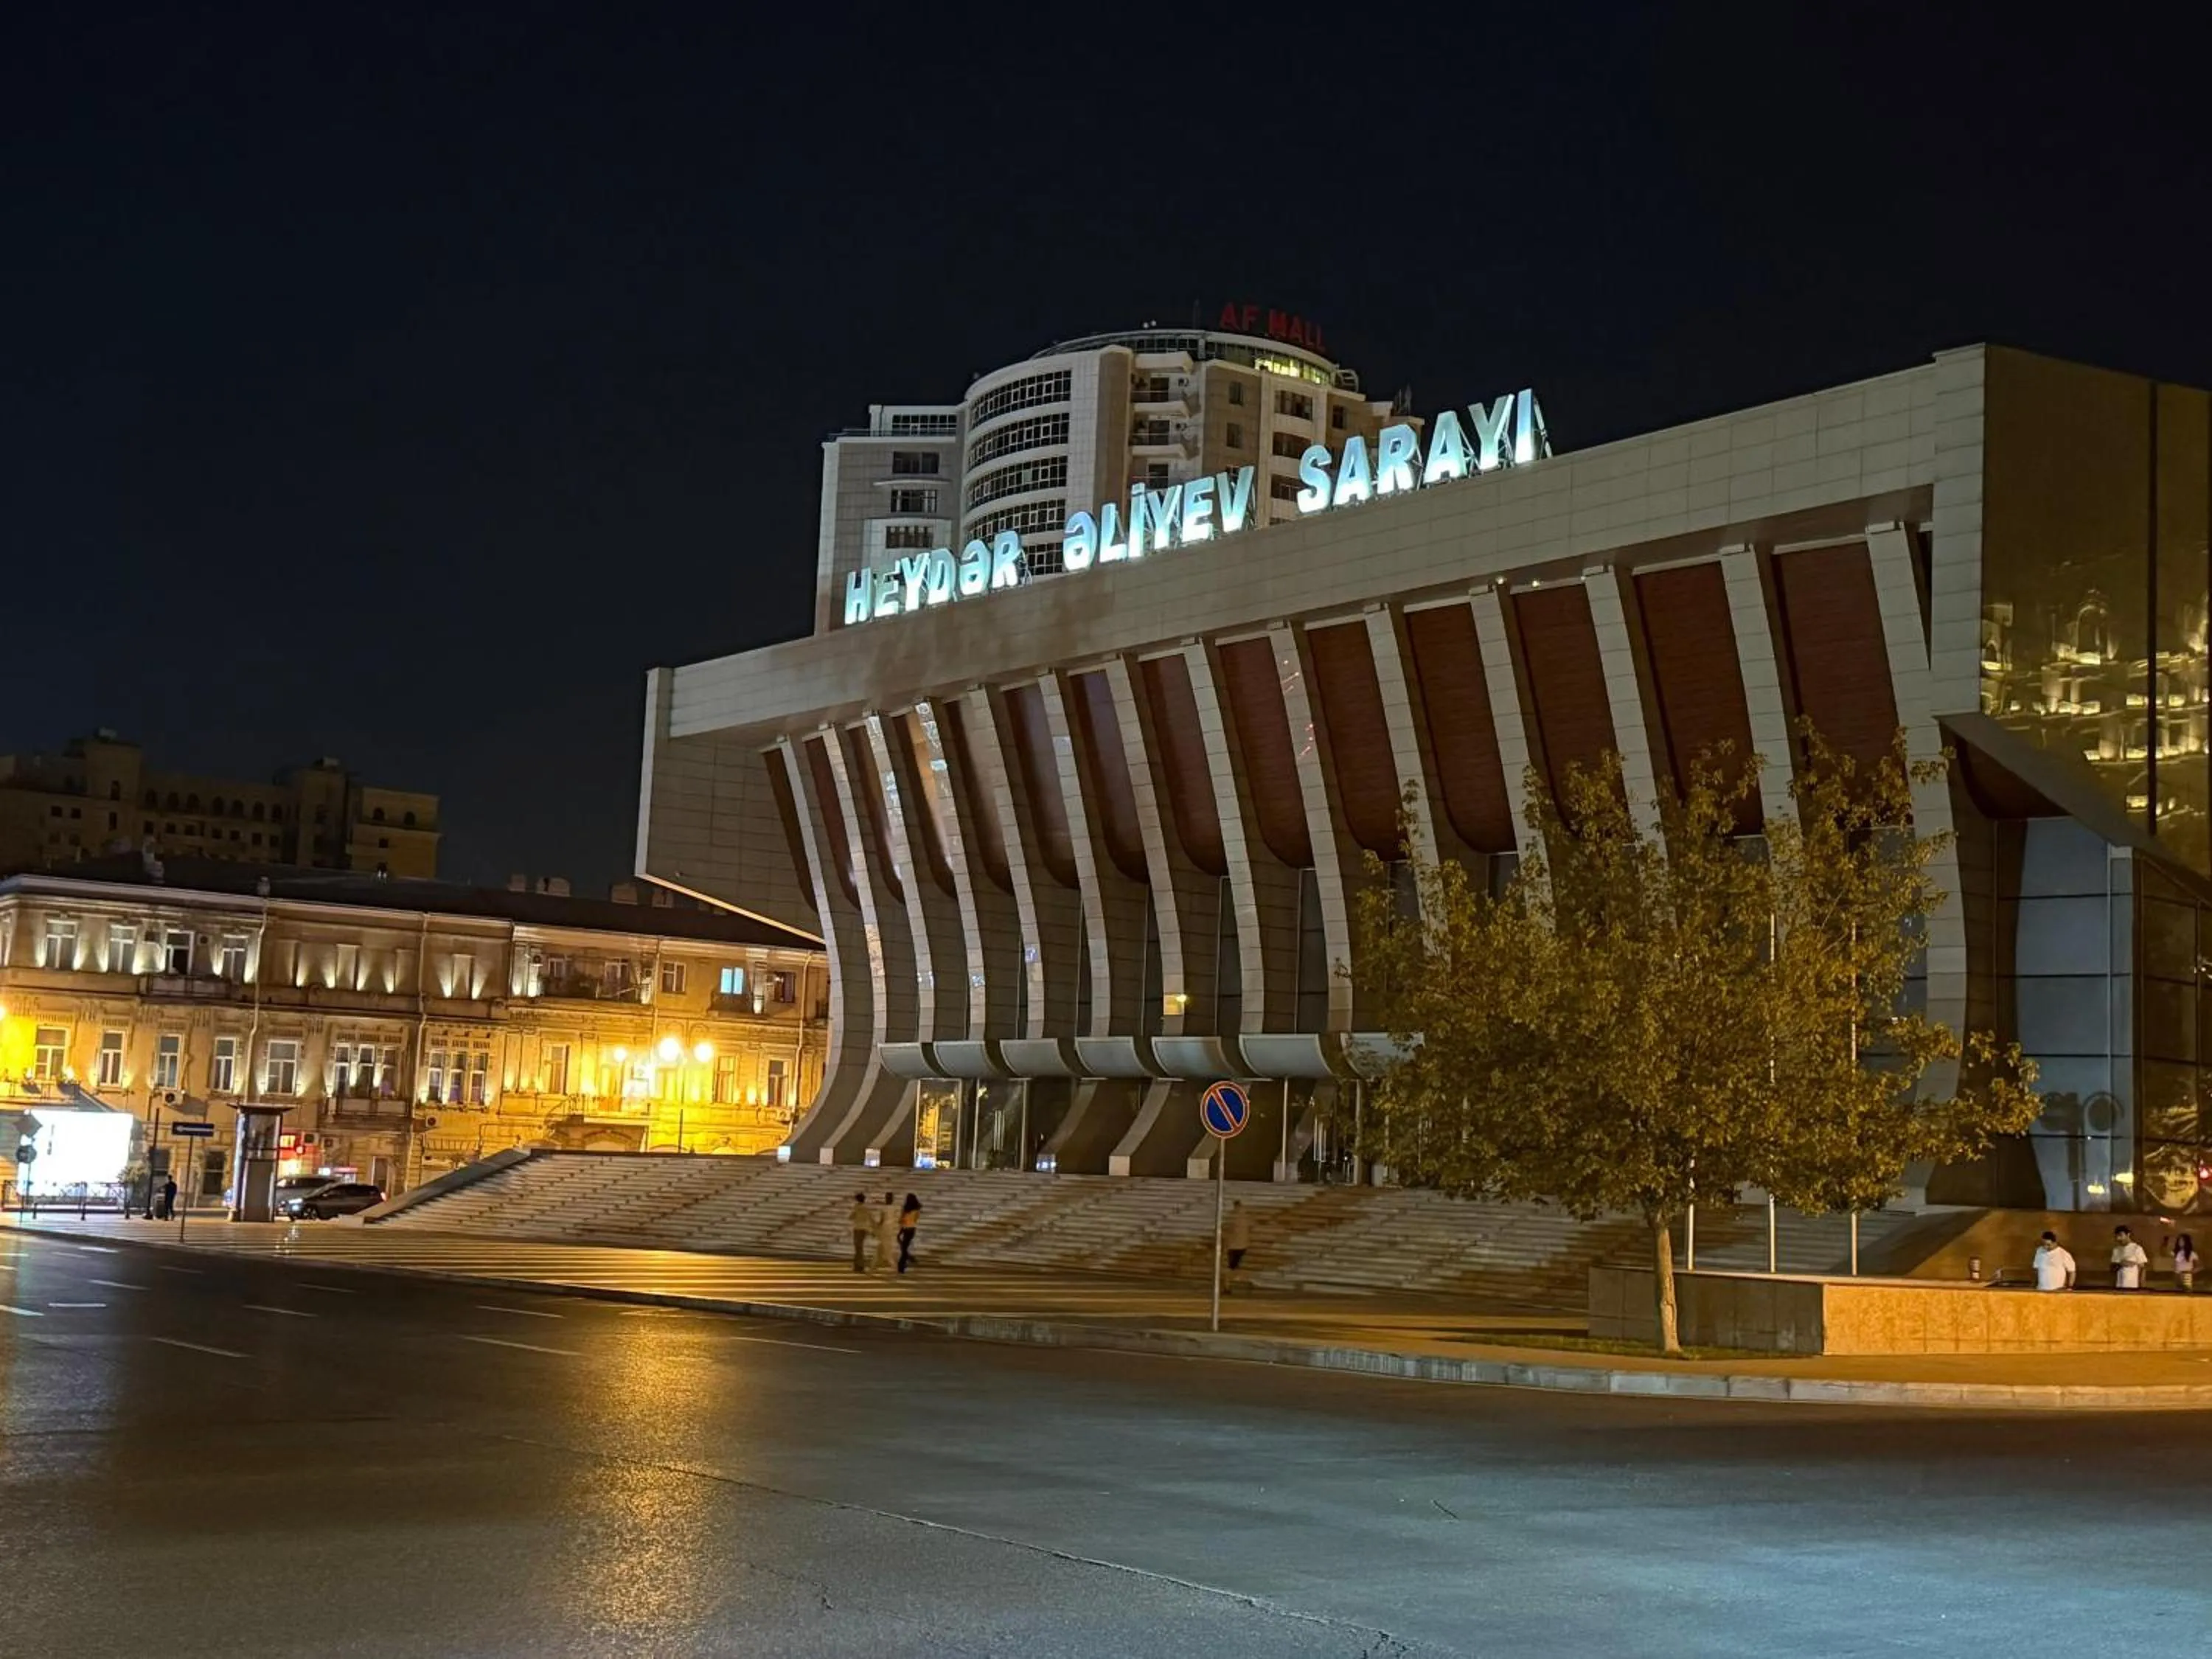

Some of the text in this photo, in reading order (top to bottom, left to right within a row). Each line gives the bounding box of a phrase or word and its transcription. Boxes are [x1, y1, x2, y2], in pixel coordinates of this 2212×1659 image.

[1220, 302, 1327, 352] AF MALL
[844, 388, 1537, 625] HEYDƏR ƏLİYEV SARAYI
